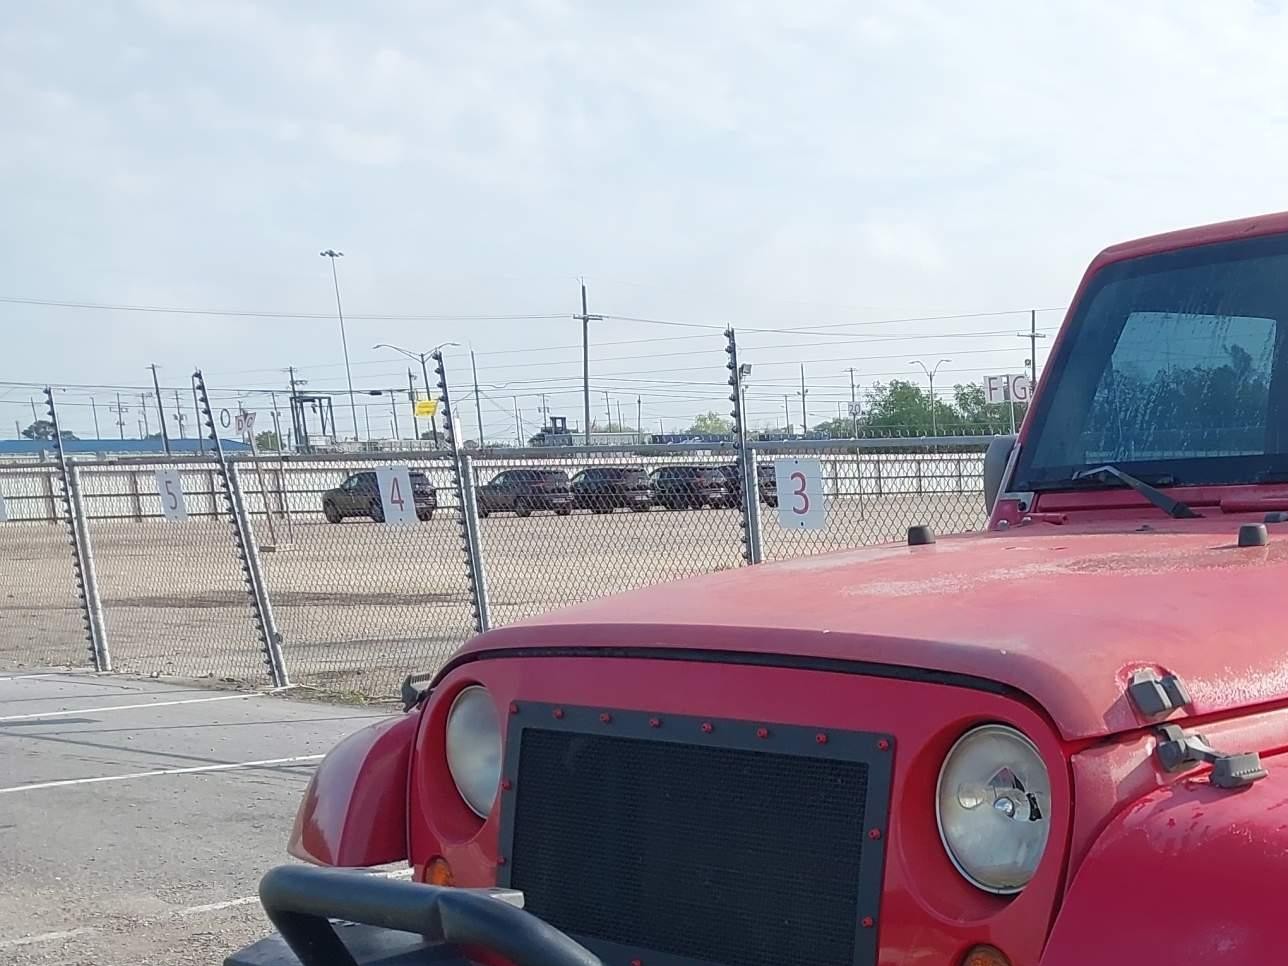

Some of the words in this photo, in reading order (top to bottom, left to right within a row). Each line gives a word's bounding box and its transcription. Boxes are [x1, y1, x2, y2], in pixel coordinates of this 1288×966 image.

[1013, 375, 1027, 400] G
[165, 480, 178, 510] 5
[390, 477, 405, 512] 4
[790, 472, 809, 515] 3
